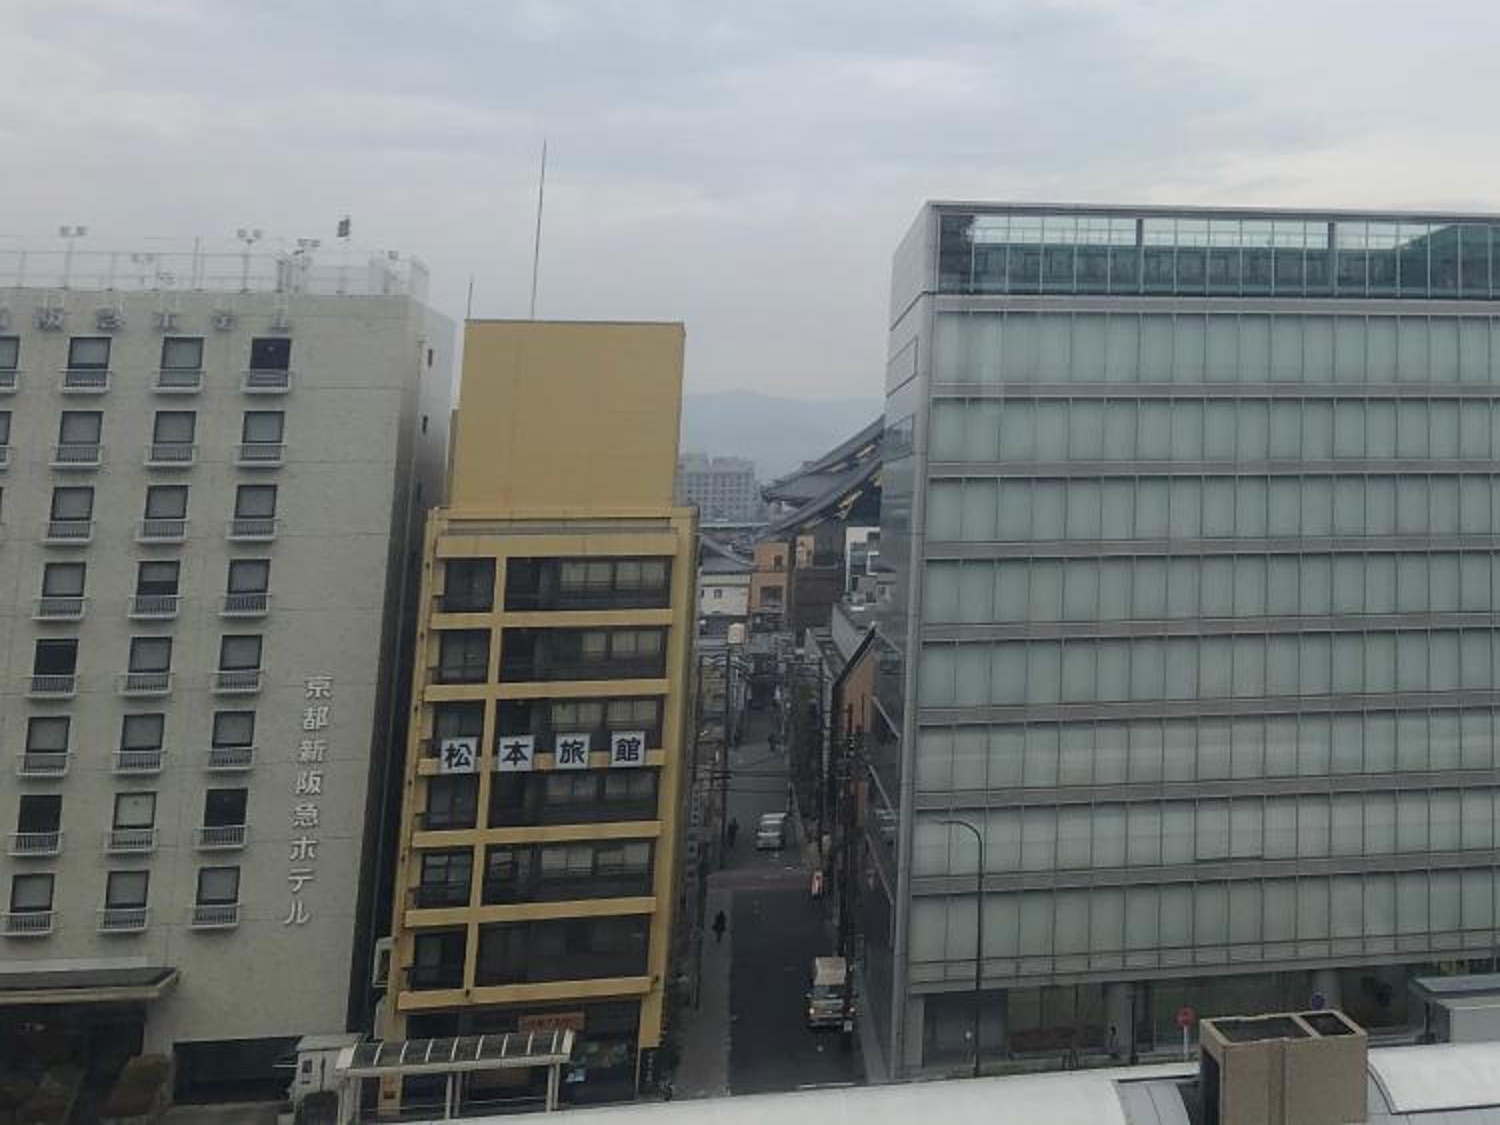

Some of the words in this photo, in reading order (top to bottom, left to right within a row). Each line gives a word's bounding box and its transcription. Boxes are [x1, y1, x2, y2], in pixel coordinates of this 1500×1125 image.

[284, 675, 335, 927] 京都新阪急ホテル
[444, 737, 642, 770] 松本旅館
